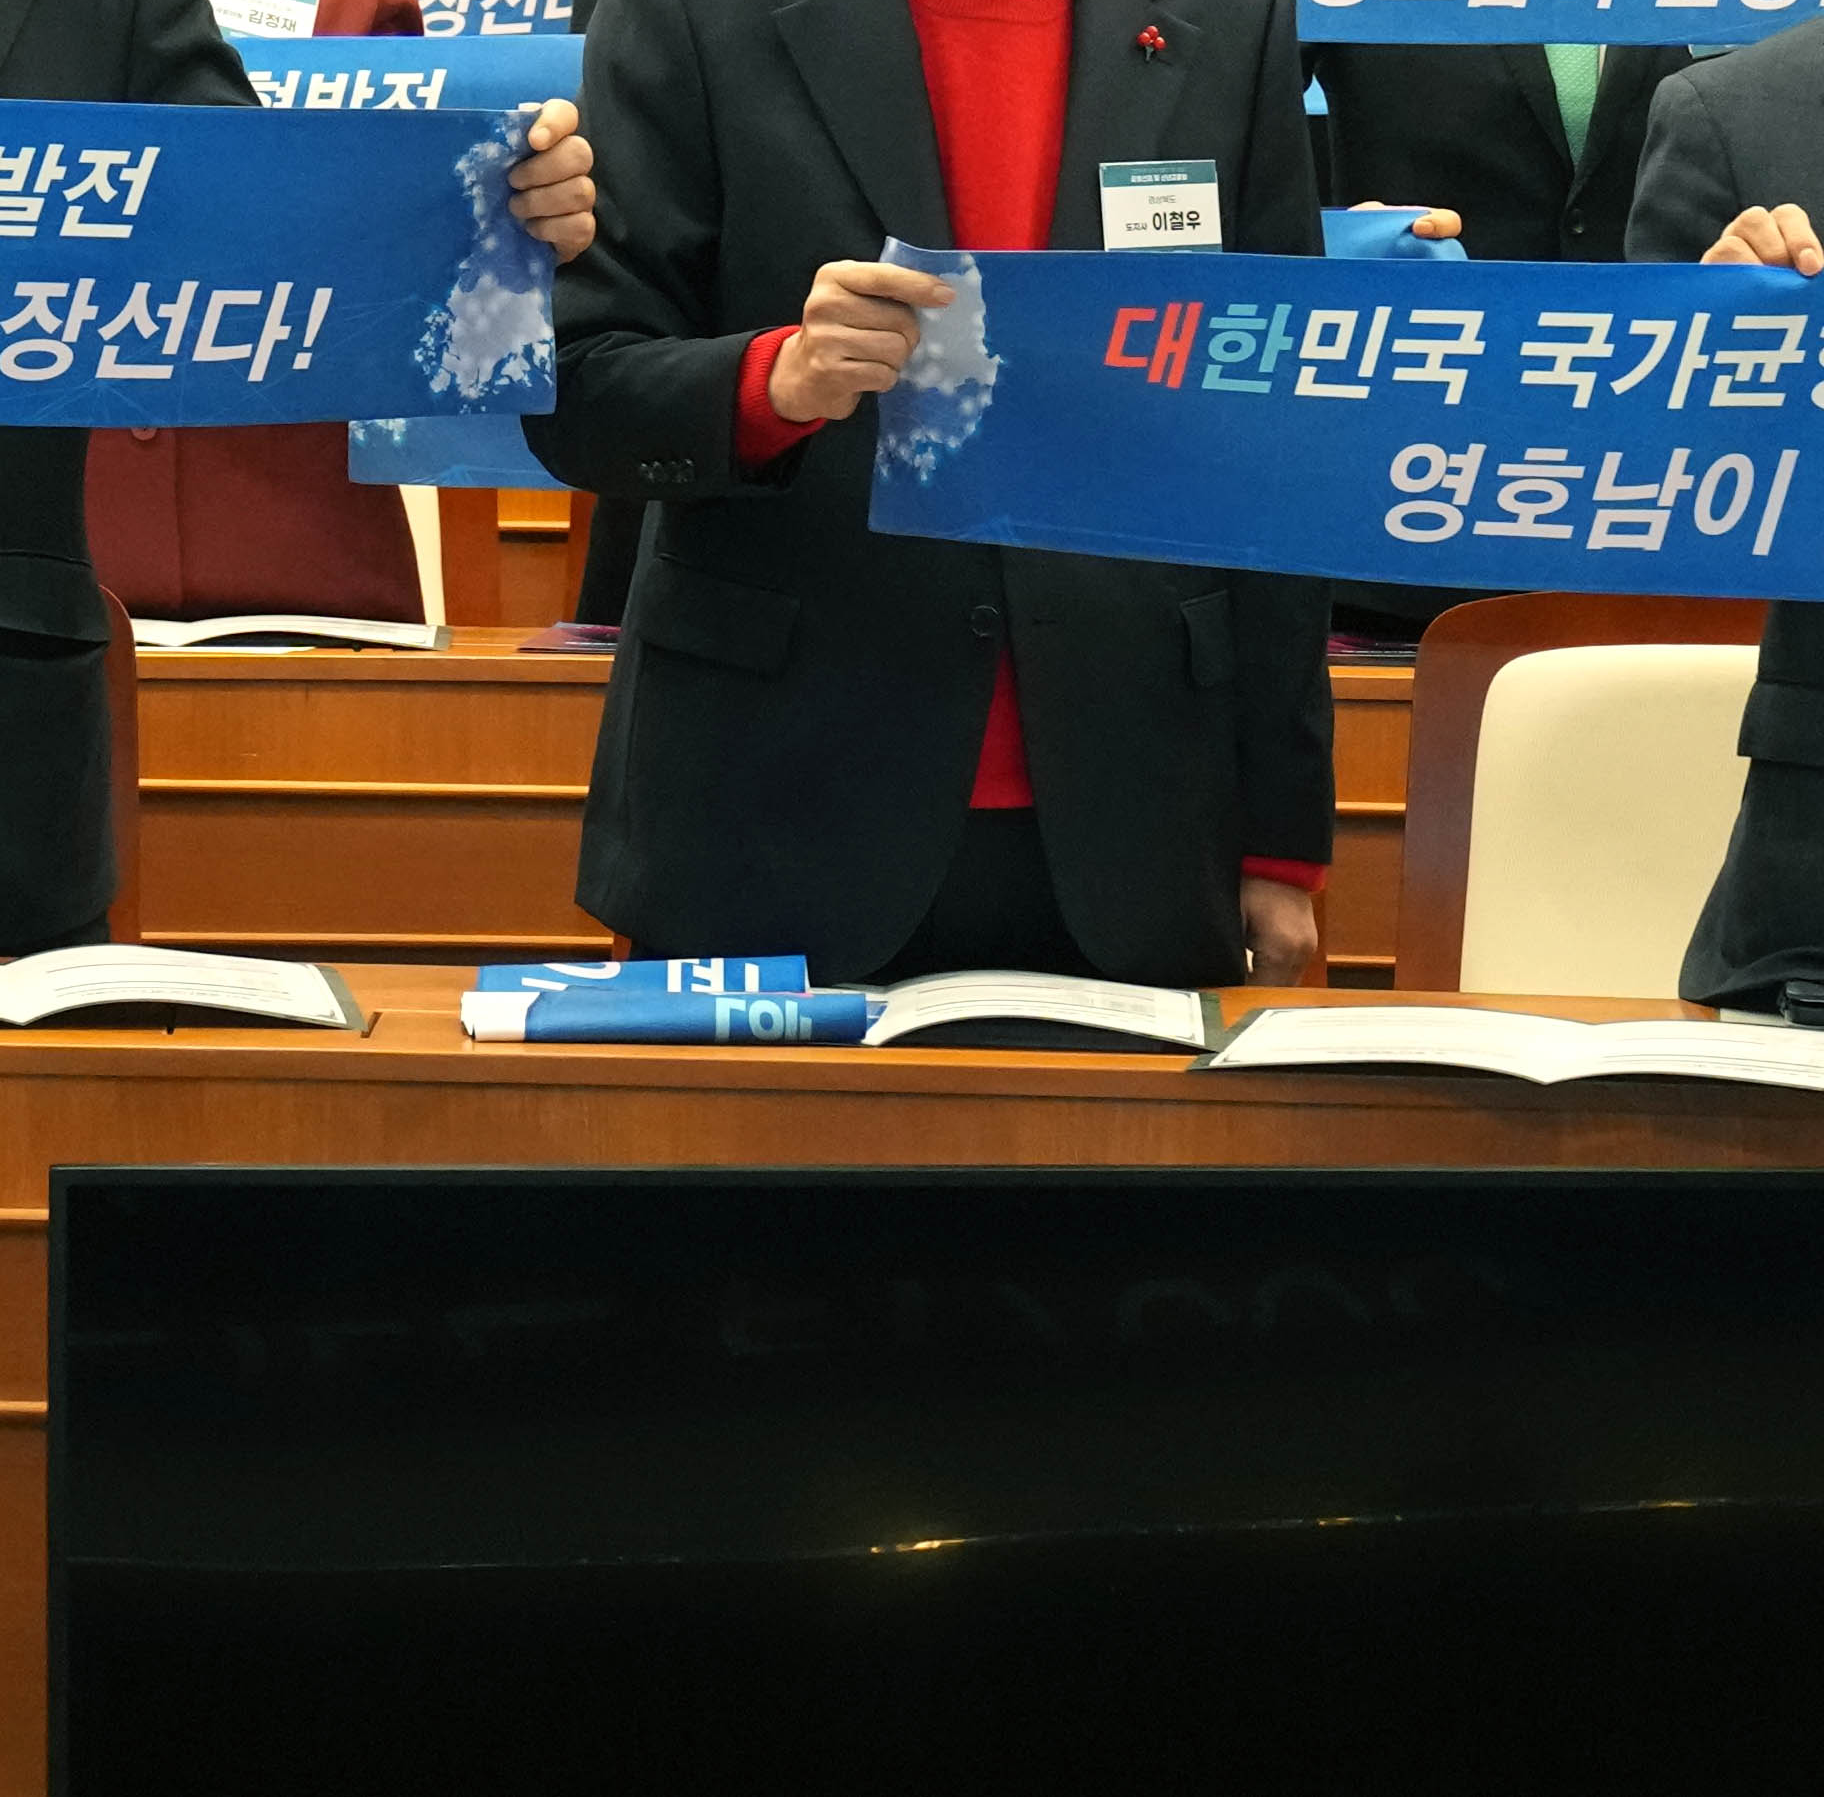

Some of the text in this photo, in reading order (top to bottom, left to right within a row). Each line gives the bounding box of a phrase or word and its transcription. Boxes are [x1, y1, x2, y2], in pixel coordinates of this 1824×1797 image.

[248, 8, 298, 33] 김정재
[1152, 210, 1202, 232] 이철우
[1104, 302, 1487, 405] 대한민국
[1384, 442, 1798, 556] 영호남이
